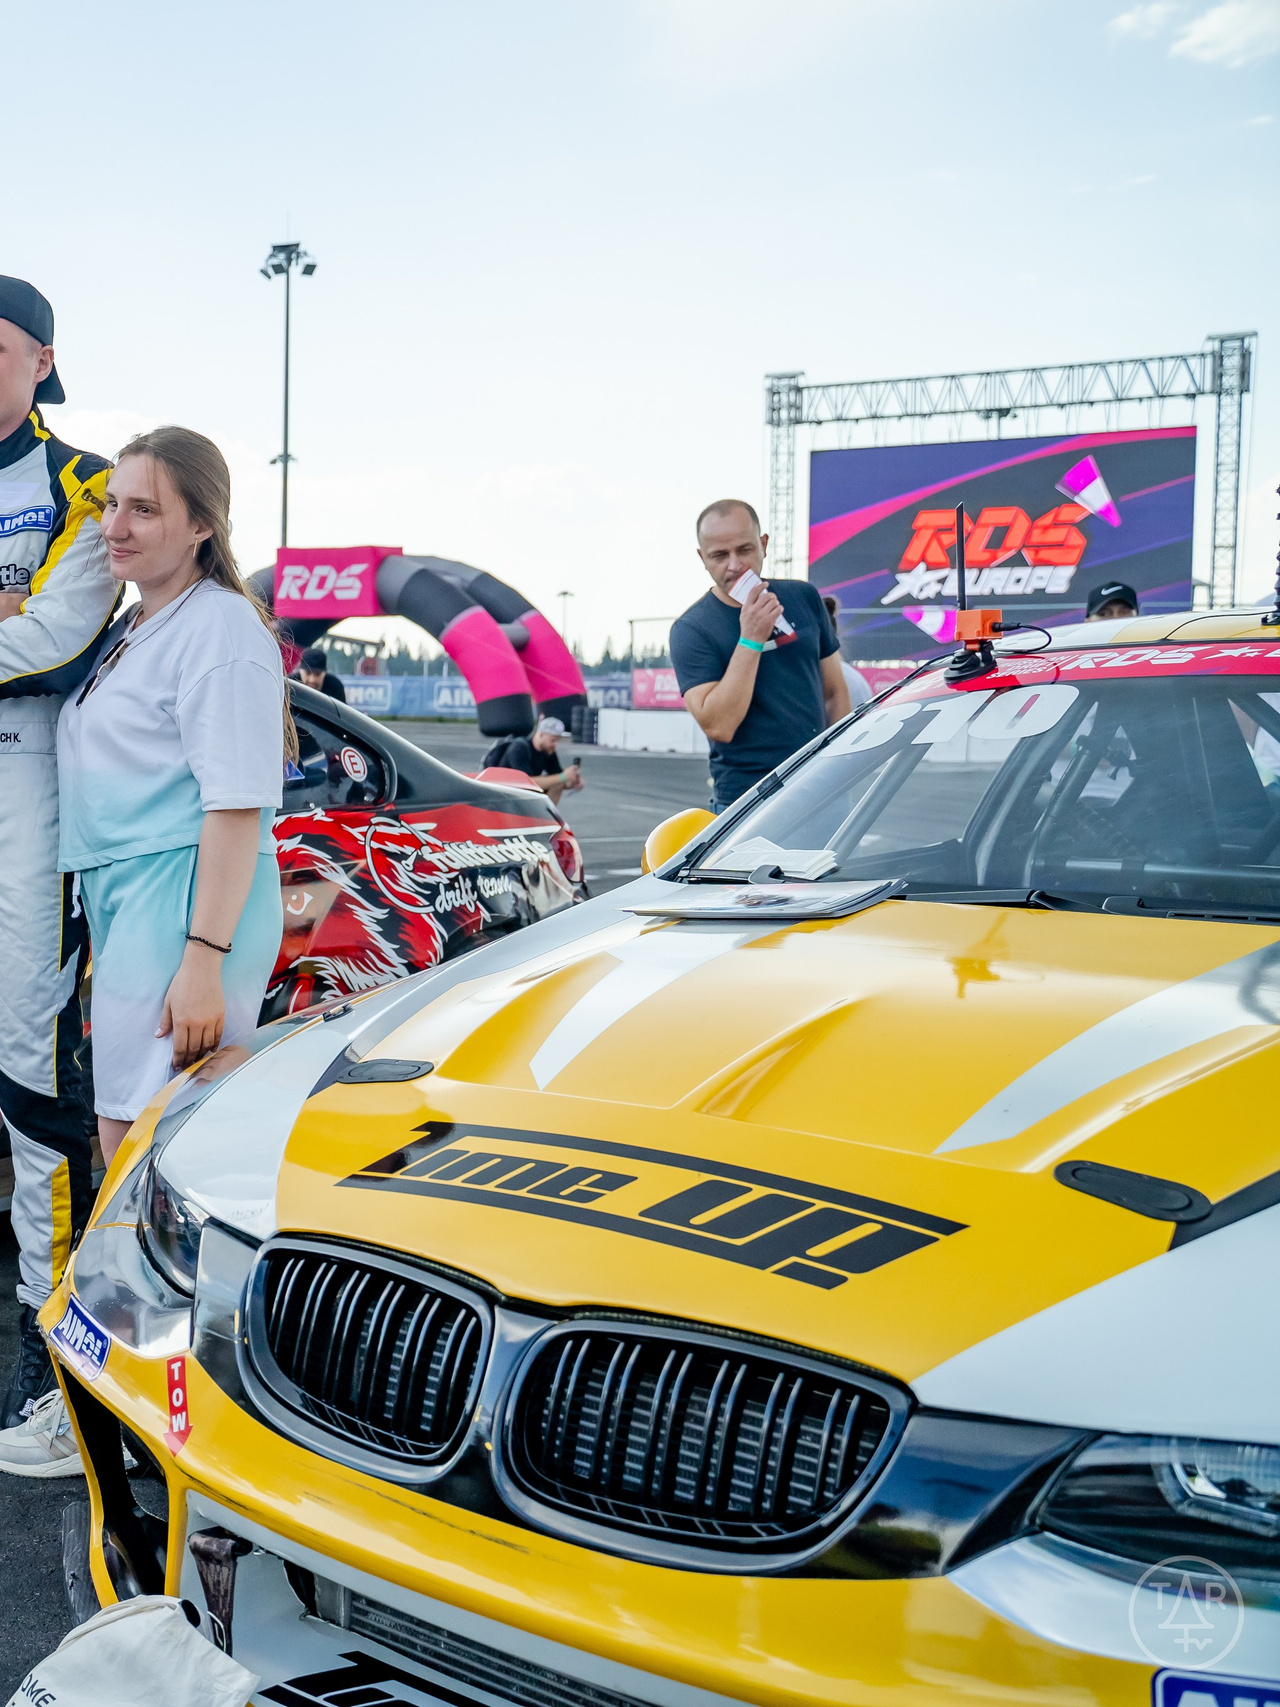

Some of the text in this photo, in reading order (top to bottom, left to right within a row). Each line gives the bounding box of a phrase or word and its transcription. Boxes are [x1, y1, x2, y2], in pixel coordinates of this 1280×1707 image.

[898, 503, 1091, 570] RDS
[276, 563, 369, 600] RDS
[941, 565, 1077, 595] EUROPE
[1060, 646, 1216, 672] RDS
[345, 686, 385, 705] MOL
[439, 687, 476, 706] AIM
[588, 689, 629, 708] MOL
[13, 732, 22, 743] K.
[819, 684, 1080, 758] 810
[348, 754, 362, 774] E
[422, 835, 551, 872] fullthrottle
[435, 875, 477, 914] drift
[58, 1306, 103, 1366] AIMOL
[170, 1360, 187, 1433] TOW
